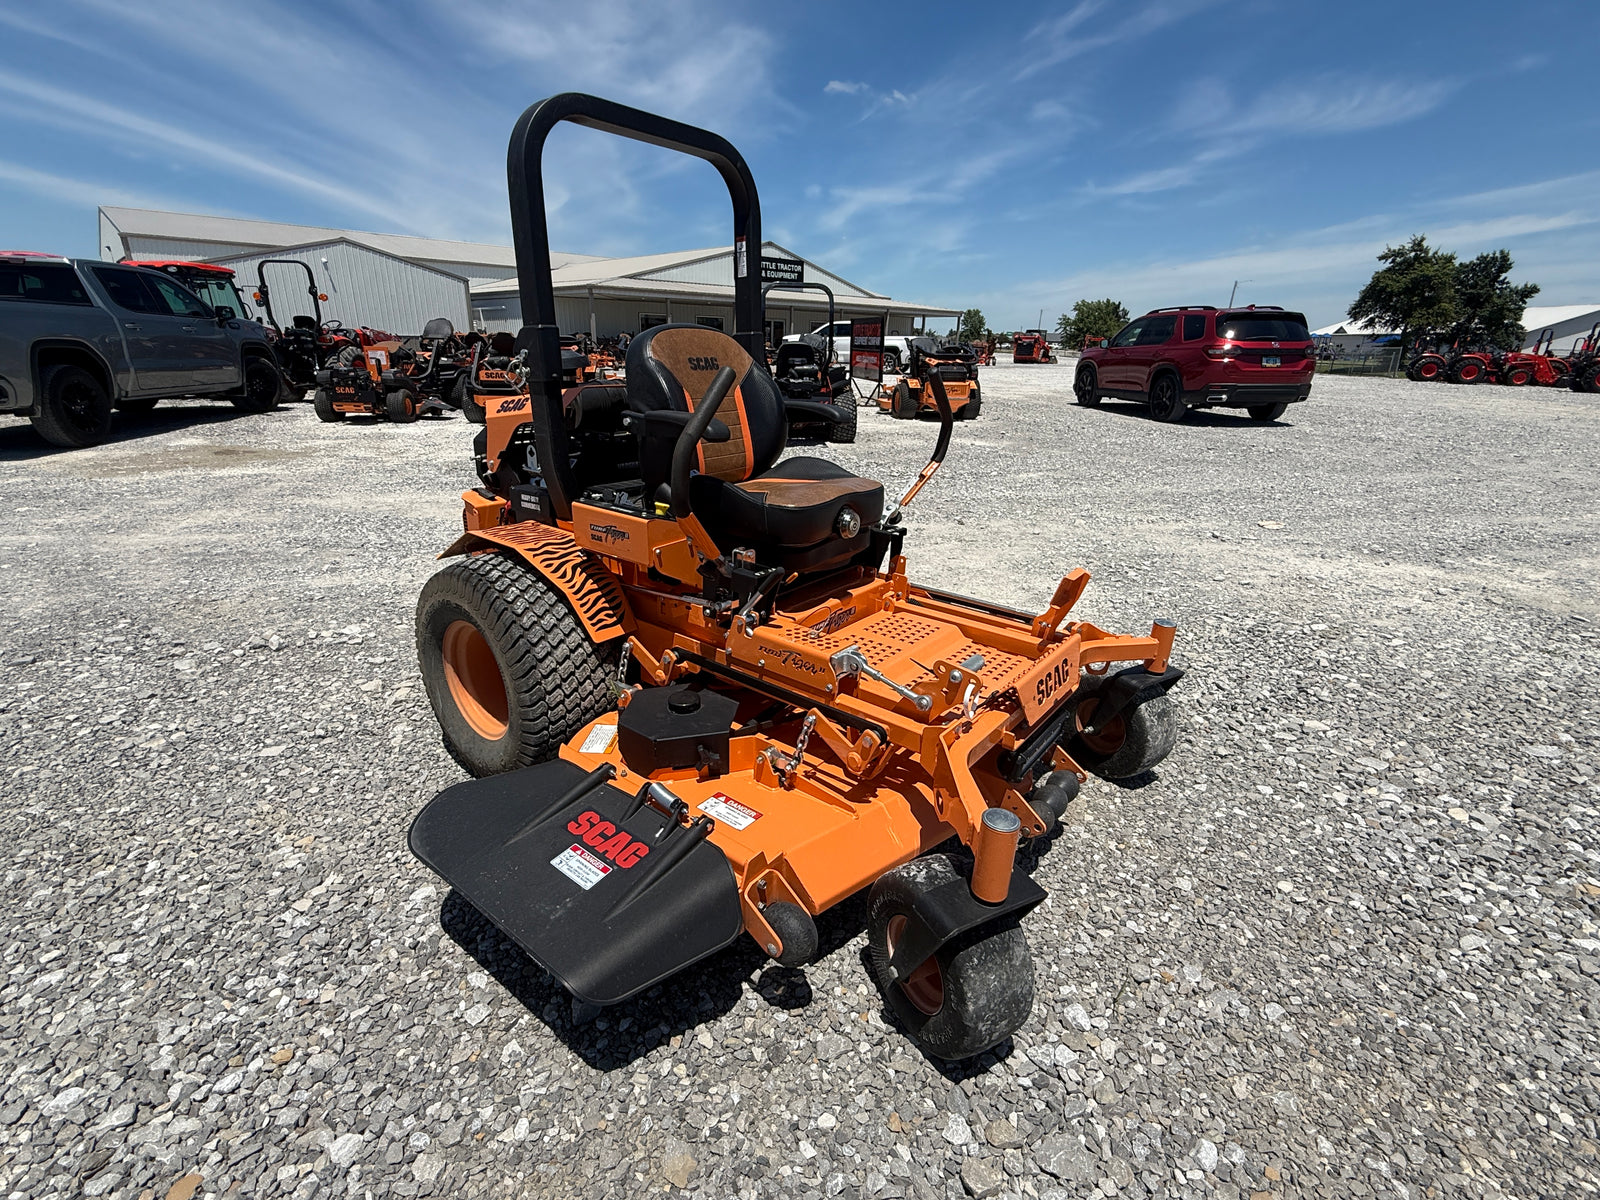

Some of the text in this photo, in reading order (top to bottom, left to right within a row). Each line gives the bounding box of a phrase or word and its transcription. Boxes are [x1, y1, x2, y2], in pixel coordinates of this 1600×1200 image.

[761, 261, 802, 272] ITTLE TRACTOR
[767, 271, 798, 280] EQUIPMENT
[687, 356, 719, 371] SCAG
[335, 386, 355, 394] SCAG
[496, 398, 530, 414] SCAG
[1036, 657, 1069, 706] SCAG
[726, 800, 757, 817] DANGER
[567, 811, 650, 869] SCAG
[581, 852, 605, 870] DANGER
